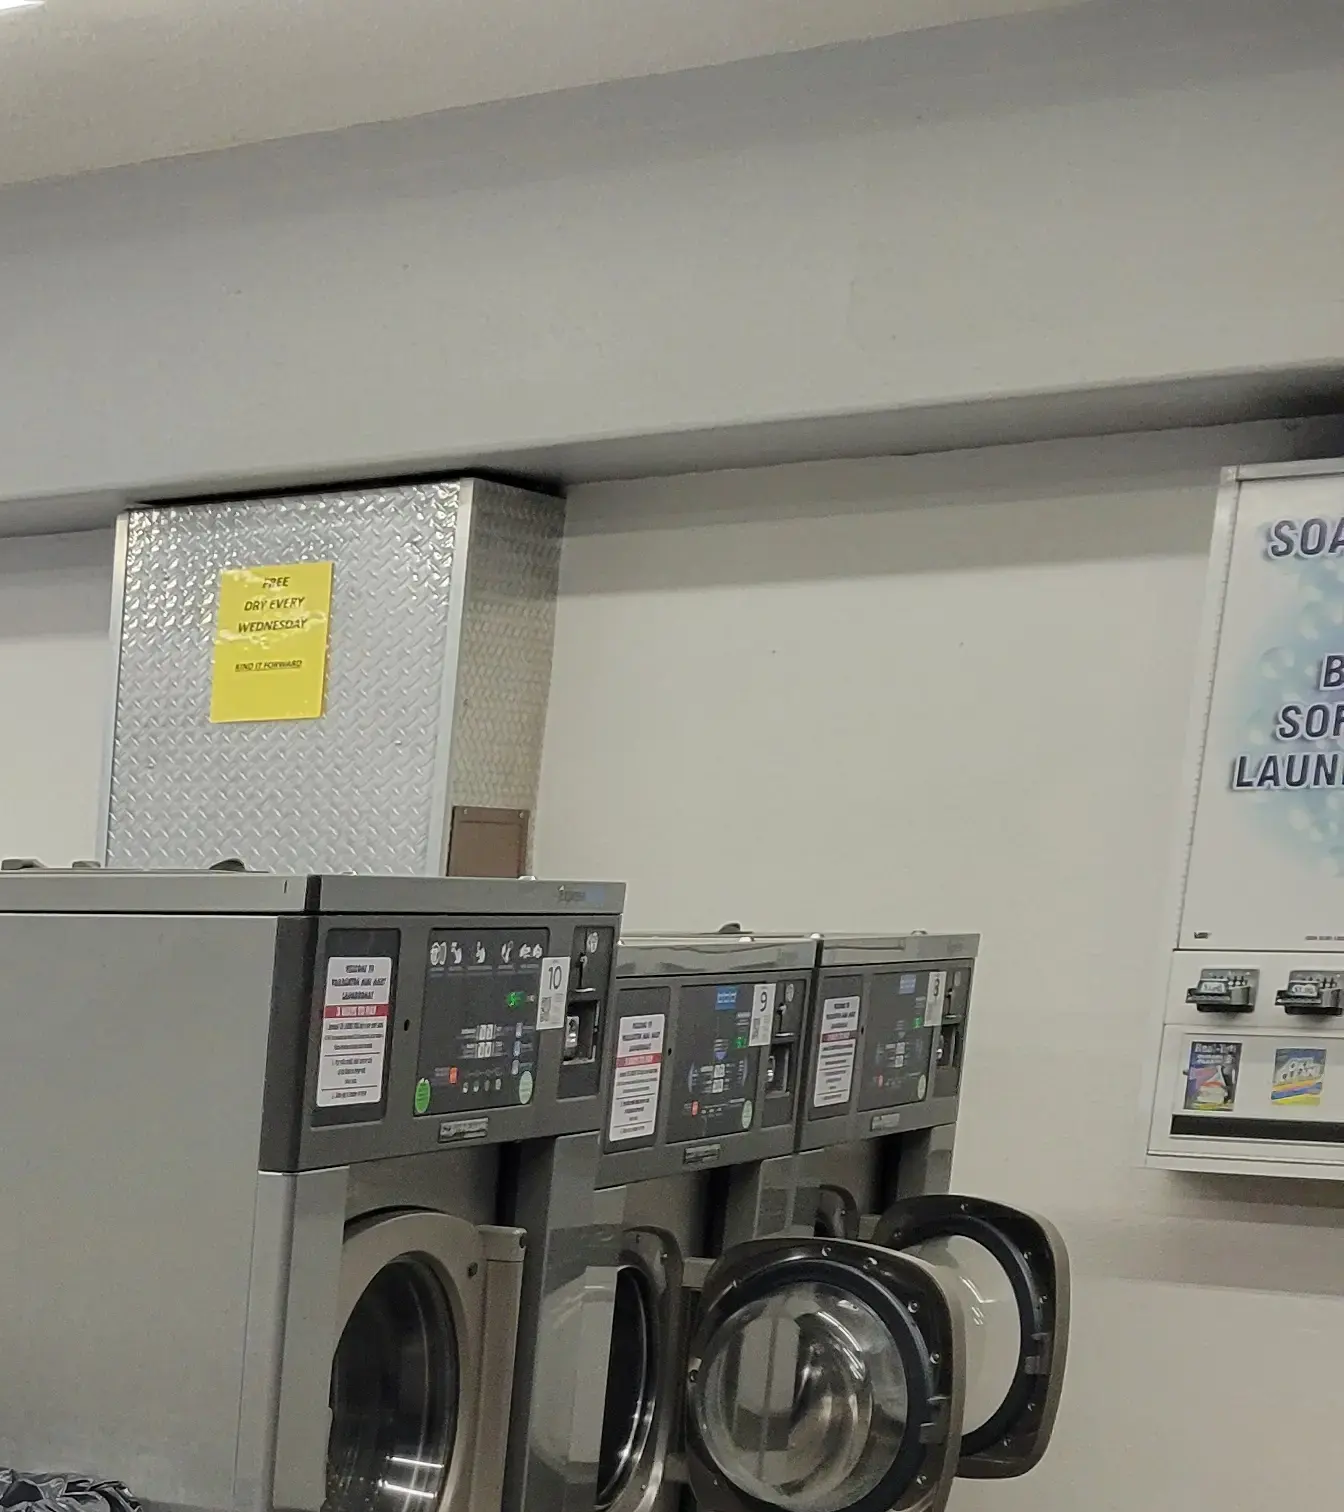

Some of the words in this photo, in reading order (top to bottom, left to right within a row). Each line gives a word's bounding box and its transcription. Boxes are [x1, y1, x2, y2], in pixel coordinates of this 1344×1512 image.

[262, 576, 290, 589] FREE
[243, 600, 267, 611] DRY
[269, 596, 306, 610] EVERY
[238, 618, 308, 633] WEDNESDAY
[1236, 753, 1344, 788] LAUN
[547, 965, 563, 990] 10
[759, 991, 768, 1013] 9
